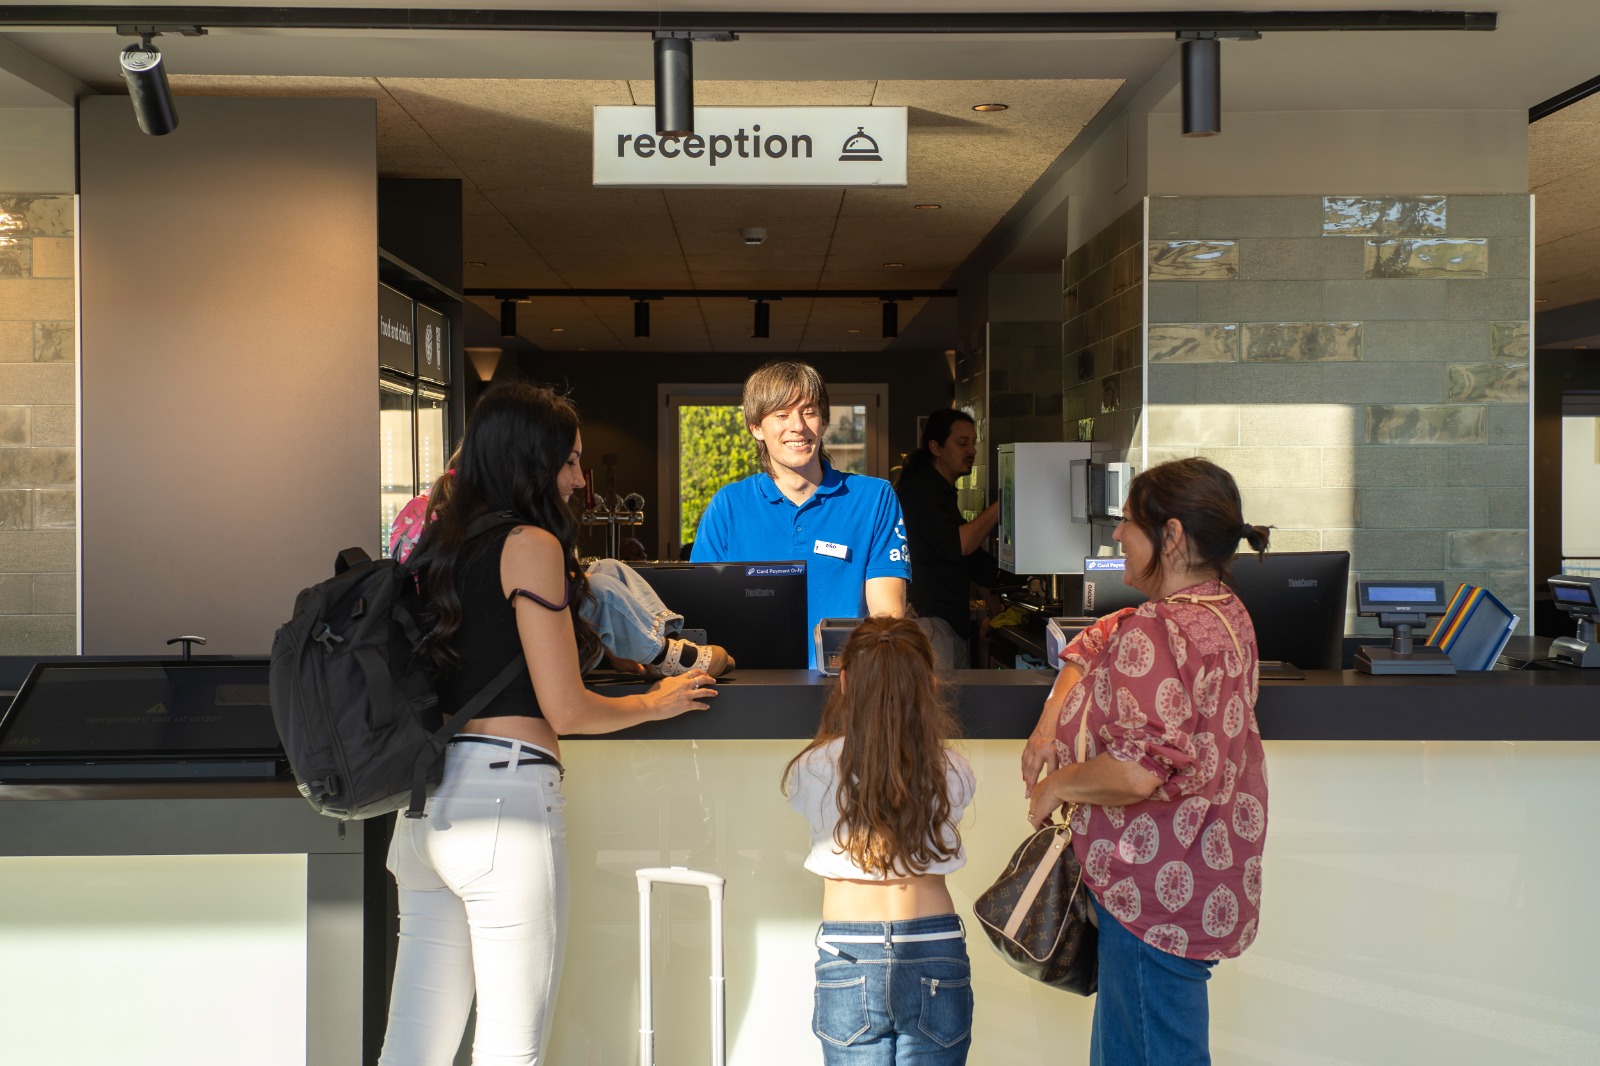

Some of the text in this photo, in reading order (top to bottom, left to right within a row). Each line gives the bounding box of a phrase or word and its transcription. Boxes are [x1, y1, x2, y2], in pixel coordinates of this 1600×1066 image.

[617, 124, 813, 167] reception
[380, 315, 411, 346] food and drinks
[85, 714, 223, 724] Temporary out of order
